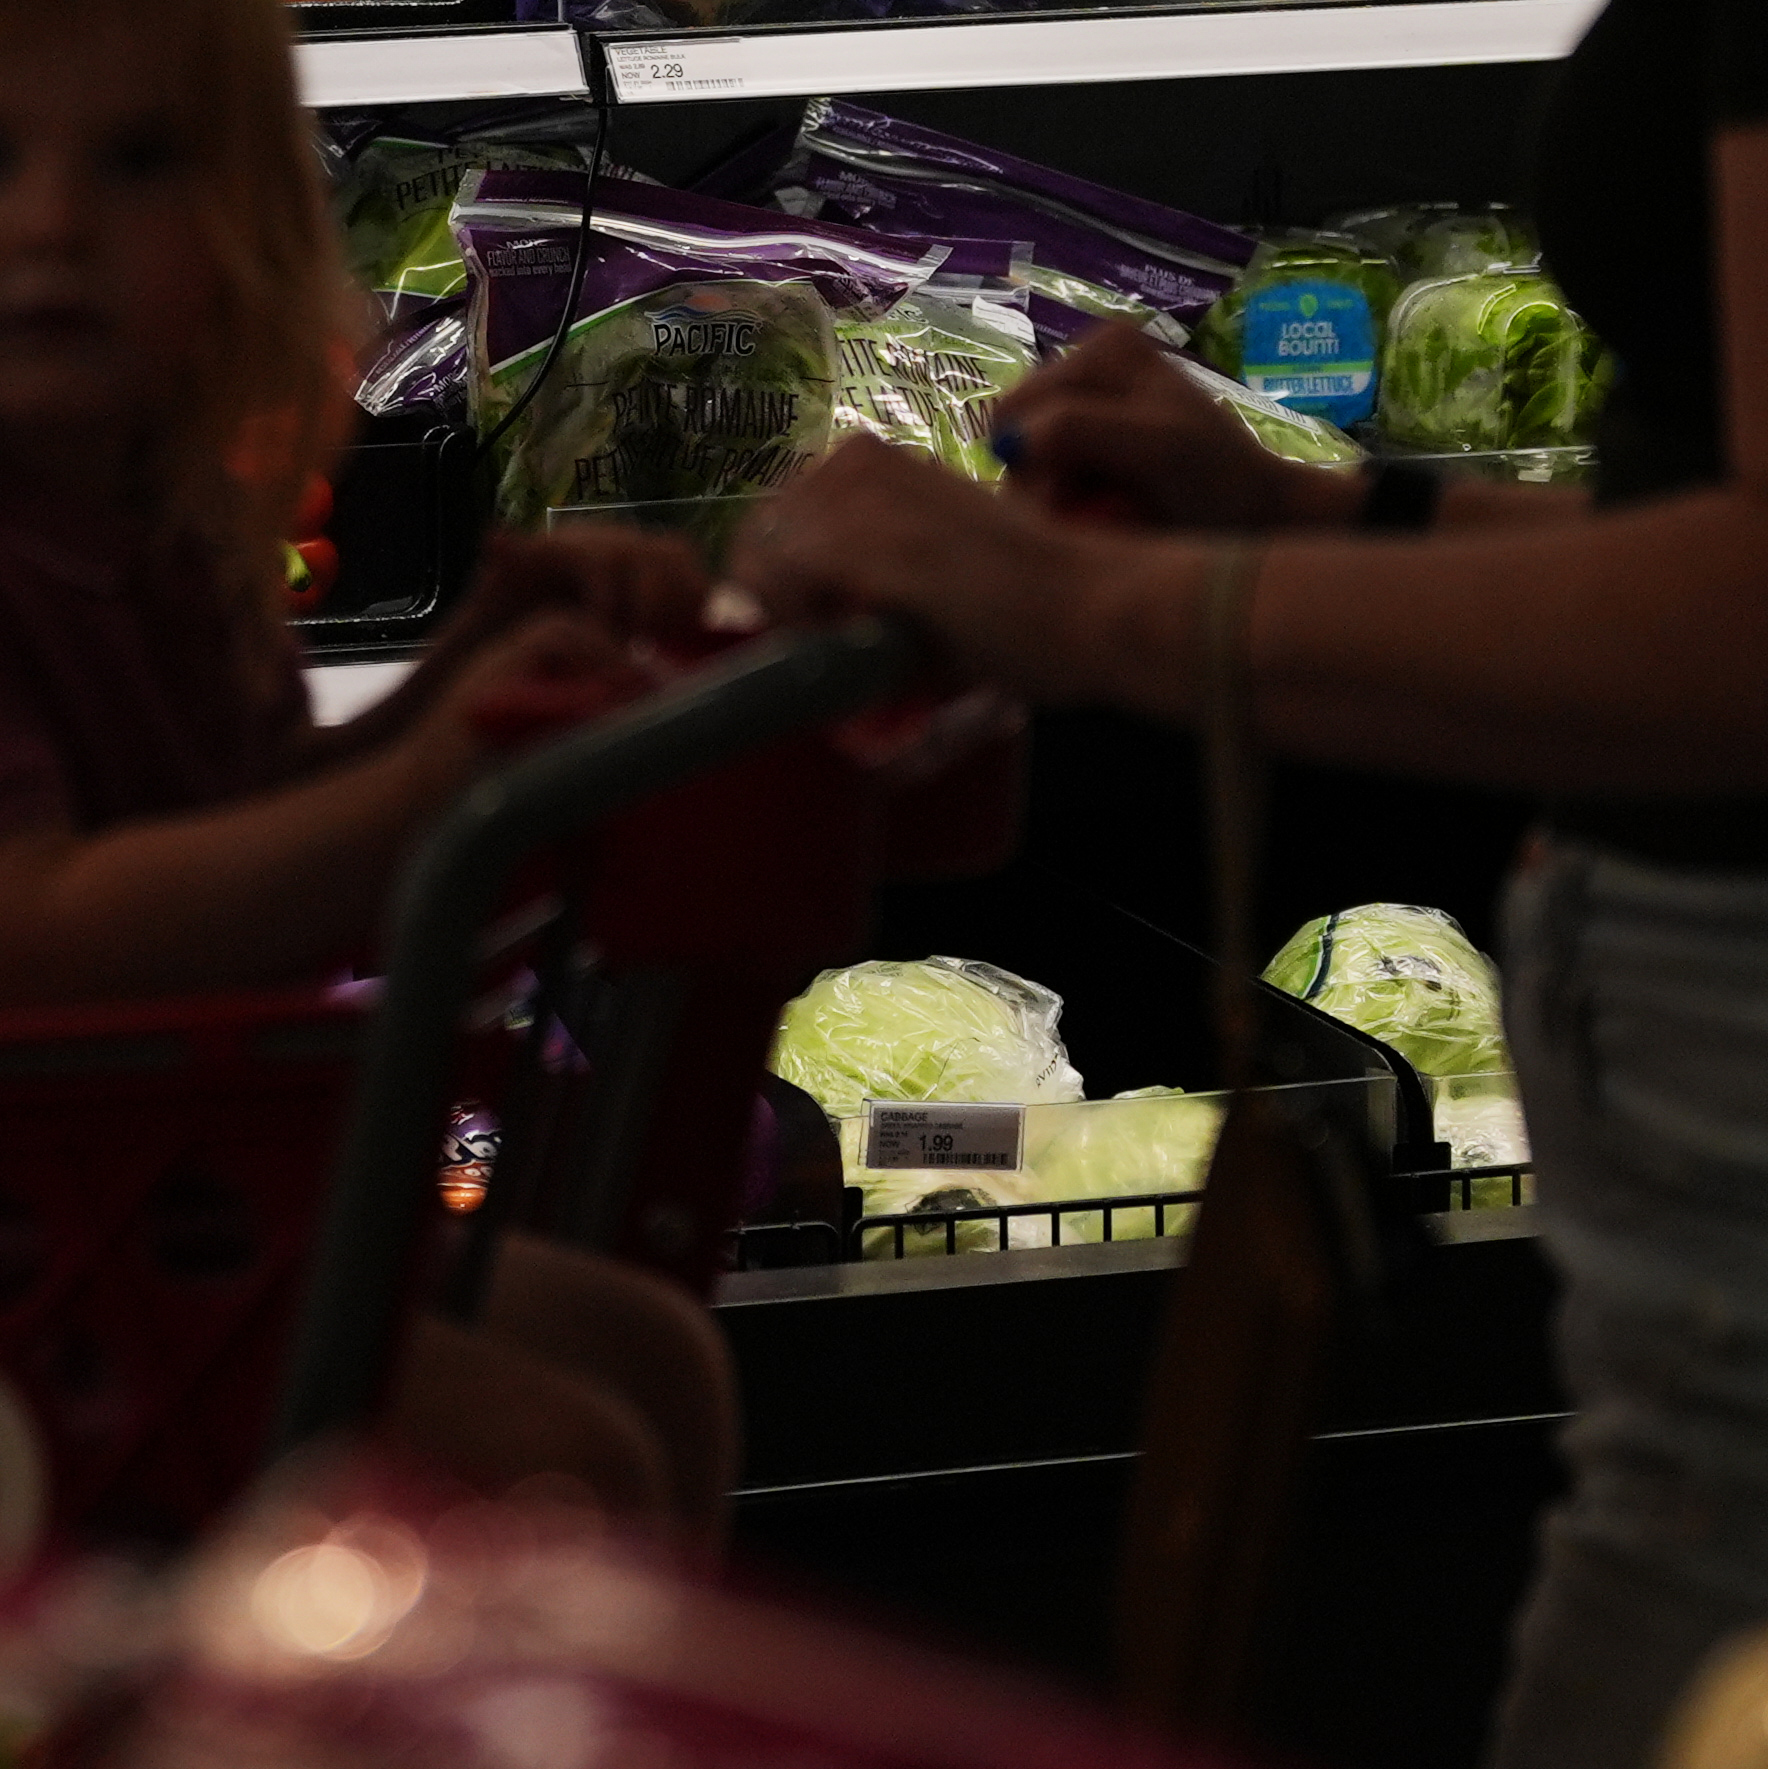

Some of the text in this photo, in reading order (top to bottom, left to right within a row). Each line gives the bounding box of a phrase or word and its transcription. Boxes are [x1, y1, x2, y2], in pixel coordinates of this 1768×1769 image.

[615, 45, 667, 55] VEGETABLE
[620, 63, 684, 80] NOW 2.29
[486, 247, 570, 266] FLAVOR AND CRUNCH
[651, 321, 757, 357] PACIFIC
[683, 392, 799, 440] ROMAINE
[880, 1112, 928, 1122] CABBAGE
[880, 1134, 953, 1152] NOW 1.99
